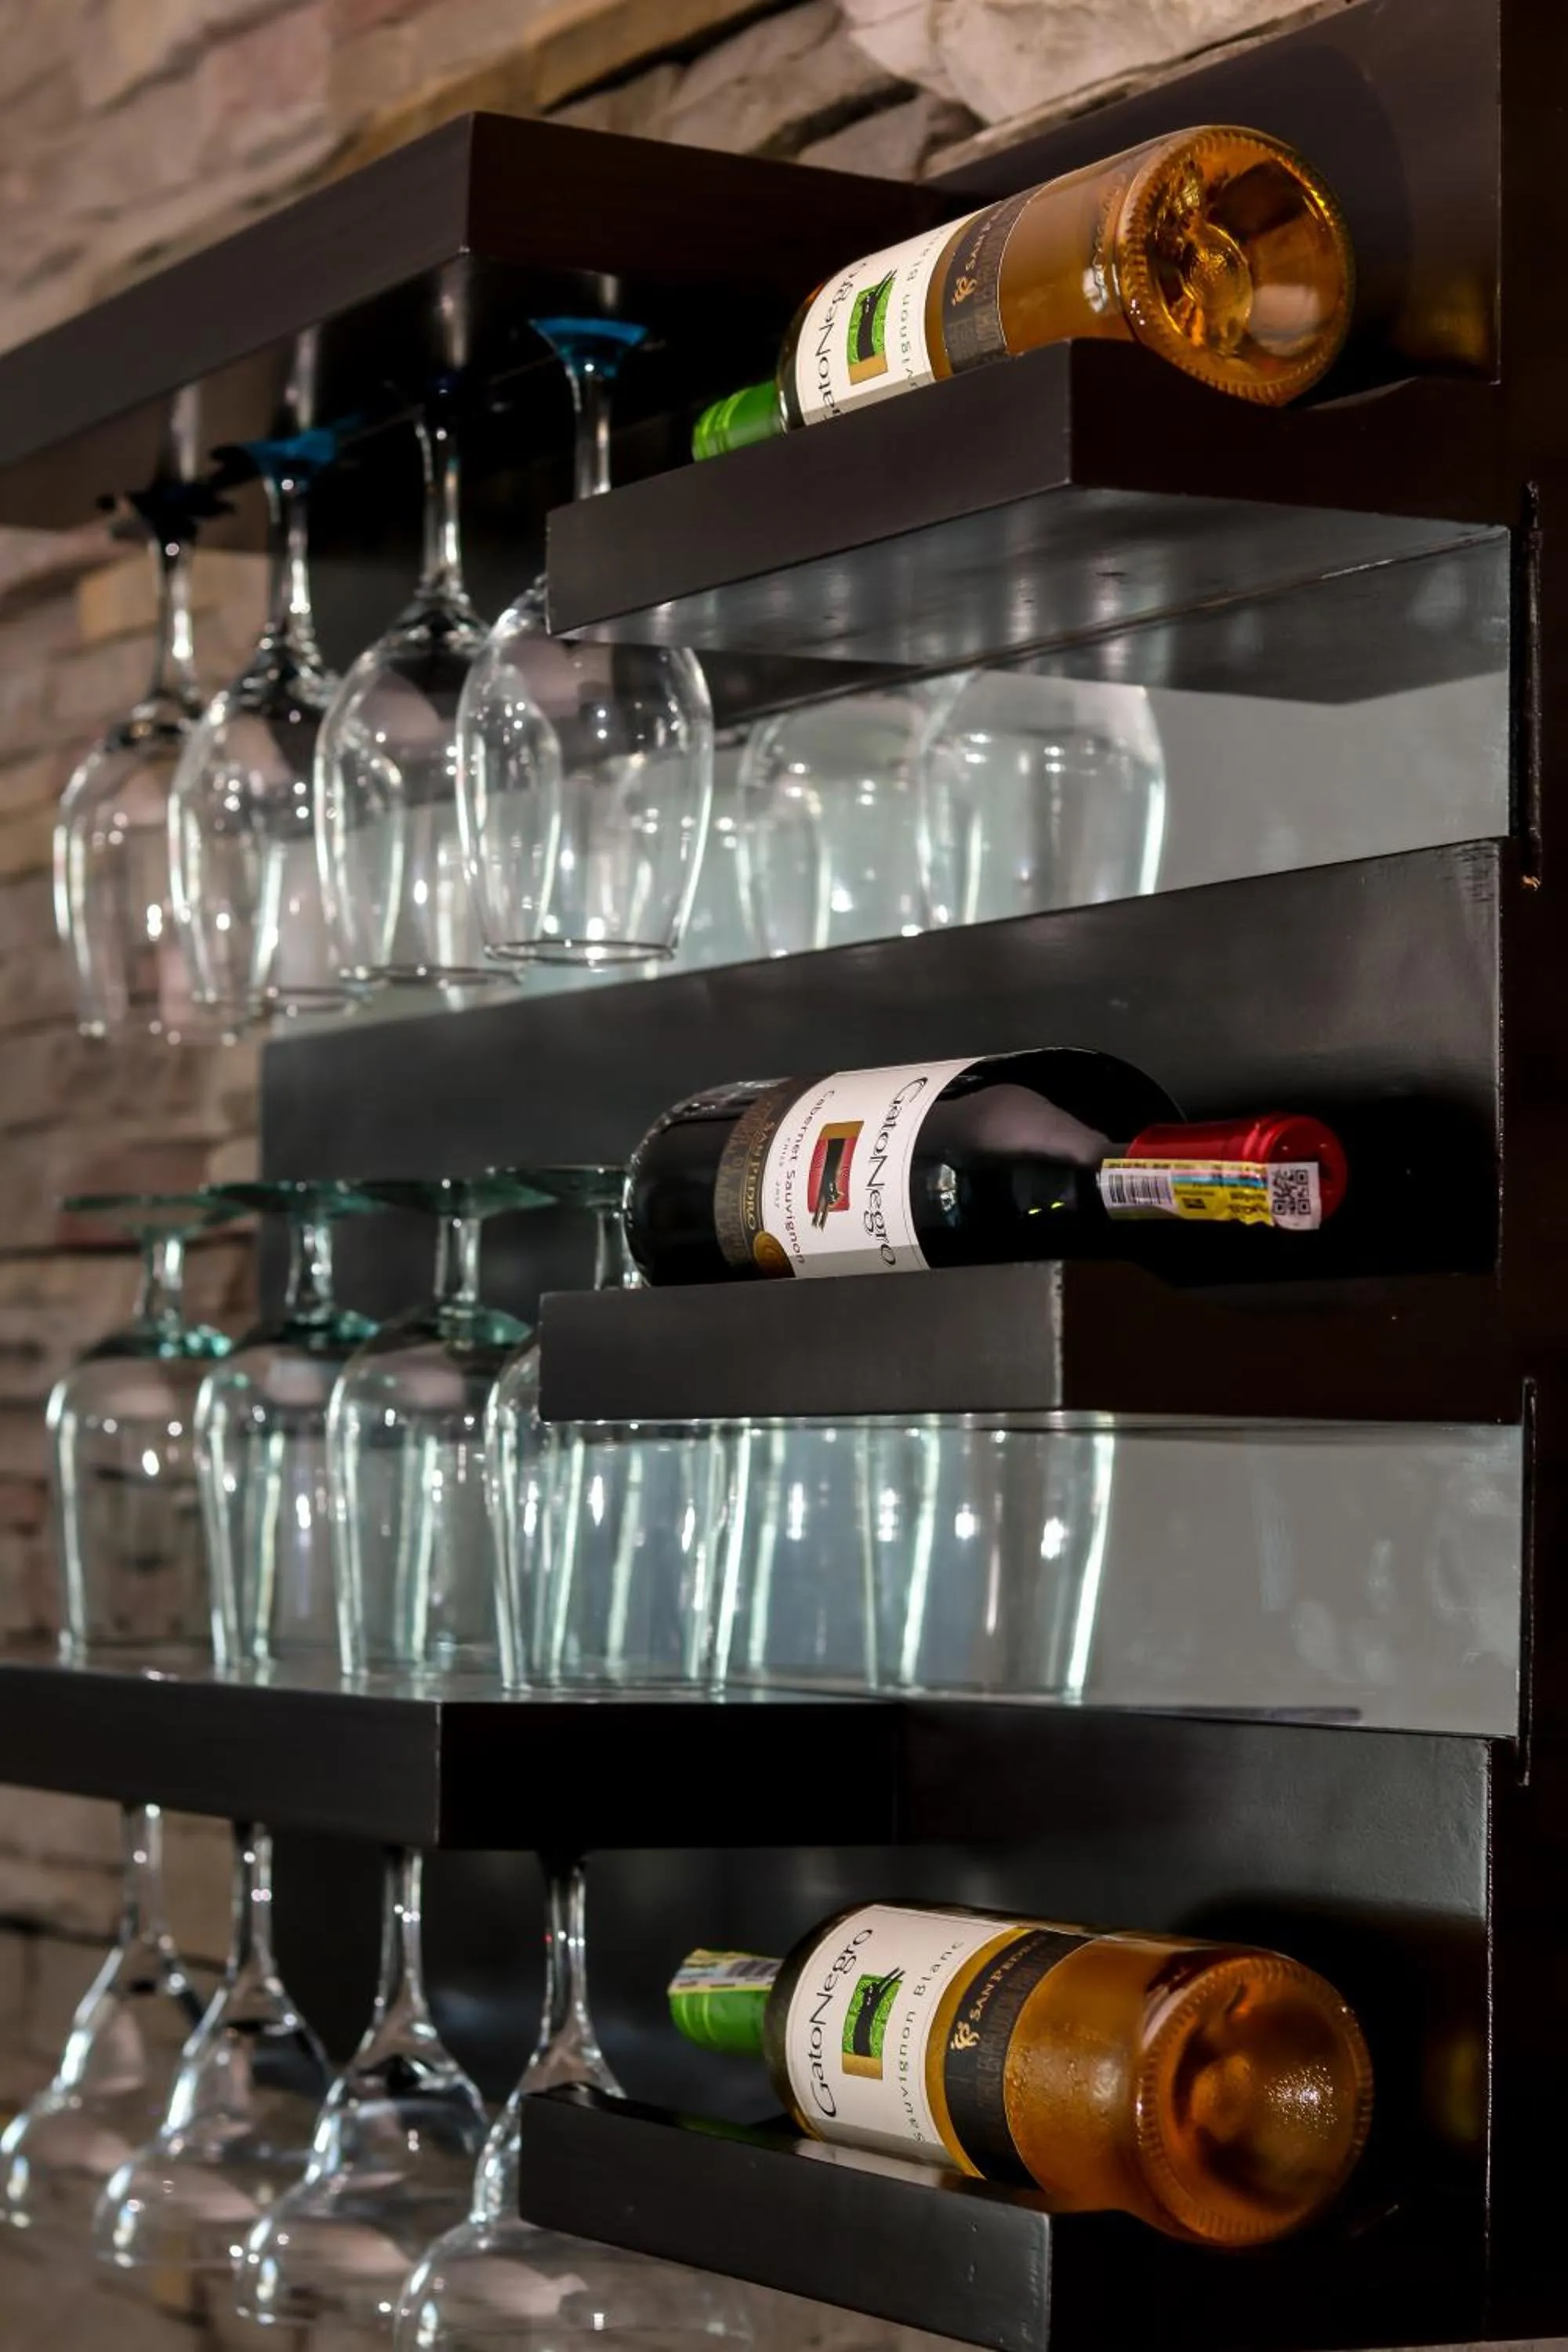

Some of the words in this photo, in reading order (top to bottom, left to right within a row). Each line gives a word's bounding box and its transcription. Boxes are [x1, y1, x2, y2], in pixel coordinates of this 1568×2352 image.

[815, 263, 866, 419] atoNegro
[790, 1089, 836, 1162] Cabernet
[863, 1076, 928, 1266] GatoNegro
[784, 1169, 806, 1265] Sauvignon
[913, 1940, 965, 1997] Blanc
[970, 1983, 994, 2021] SAN
[808, 1929, 873, 2118] GatoNegro
